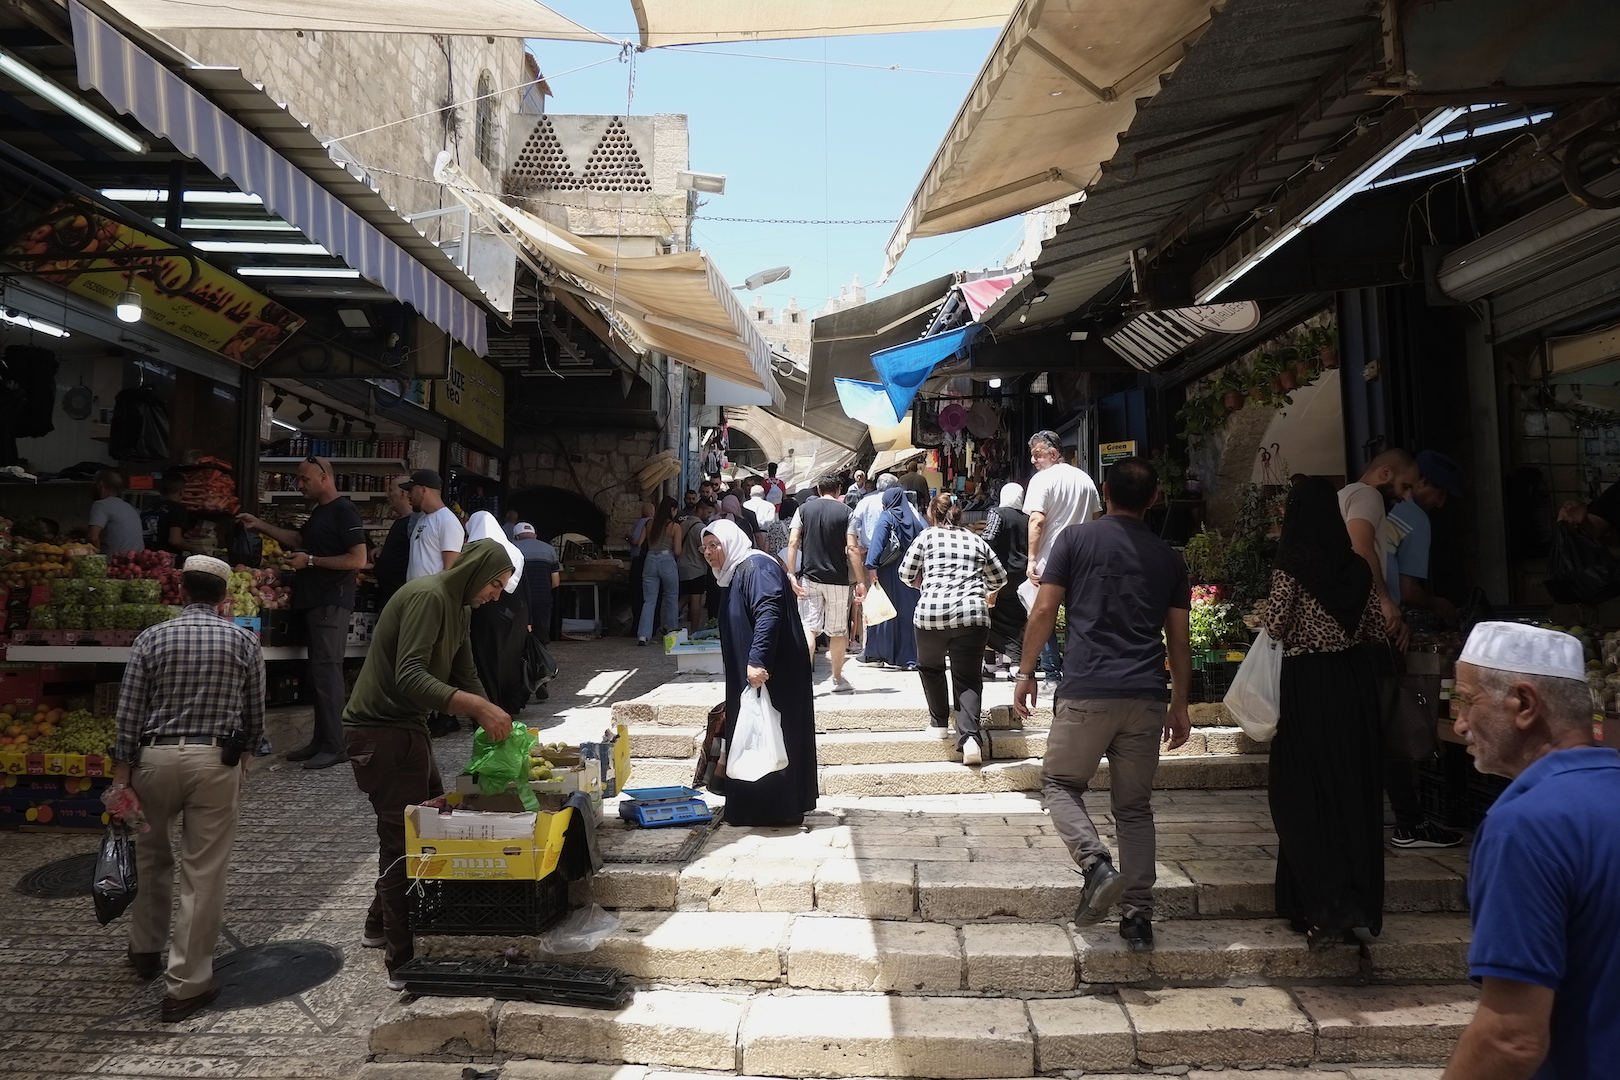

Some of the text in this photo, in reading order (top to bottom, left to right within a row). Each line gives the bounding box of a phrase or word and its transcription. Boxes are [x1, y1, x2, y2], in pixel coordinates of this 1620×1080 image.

[450, 366, 466, 392] UZE
[446, 382, 461, 405] tea
[451, 857, 508, 869] בננות
